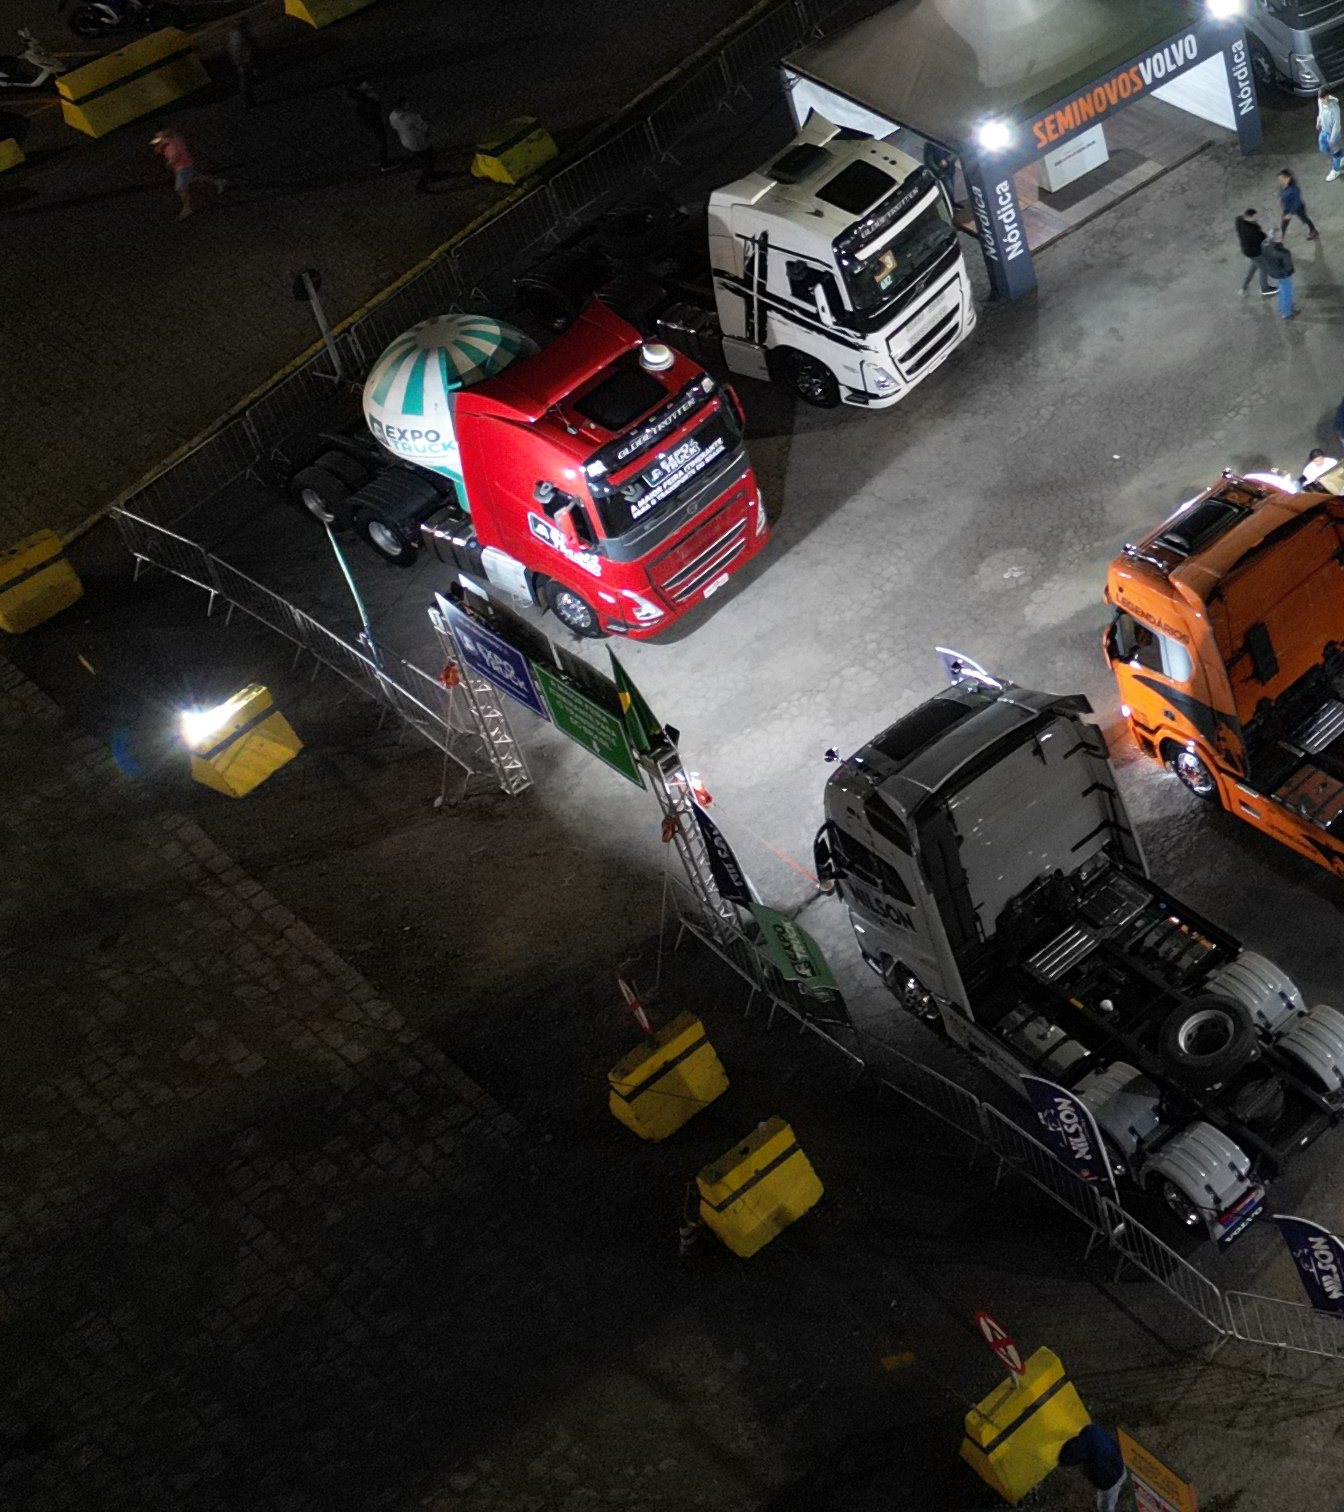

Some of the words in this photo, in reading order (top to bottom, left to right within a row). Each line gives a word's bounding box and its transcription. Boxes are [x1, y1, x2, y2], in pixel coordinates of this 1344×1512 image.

[1032, 64, 1145, 150] SEMINOVOS
[1138, 33, 1200, 87] VOLVO
[1231, 38, 1254, 116] Nórdica
[970, 185, 998, 262] Nórdica
[994, 179, 1024, 262] Nórdica
[386, 424, 441, 443] EXPO
[393, 439, 457, 455] TRUCK
[1054, 1096, 1093, 1161] NILSON
